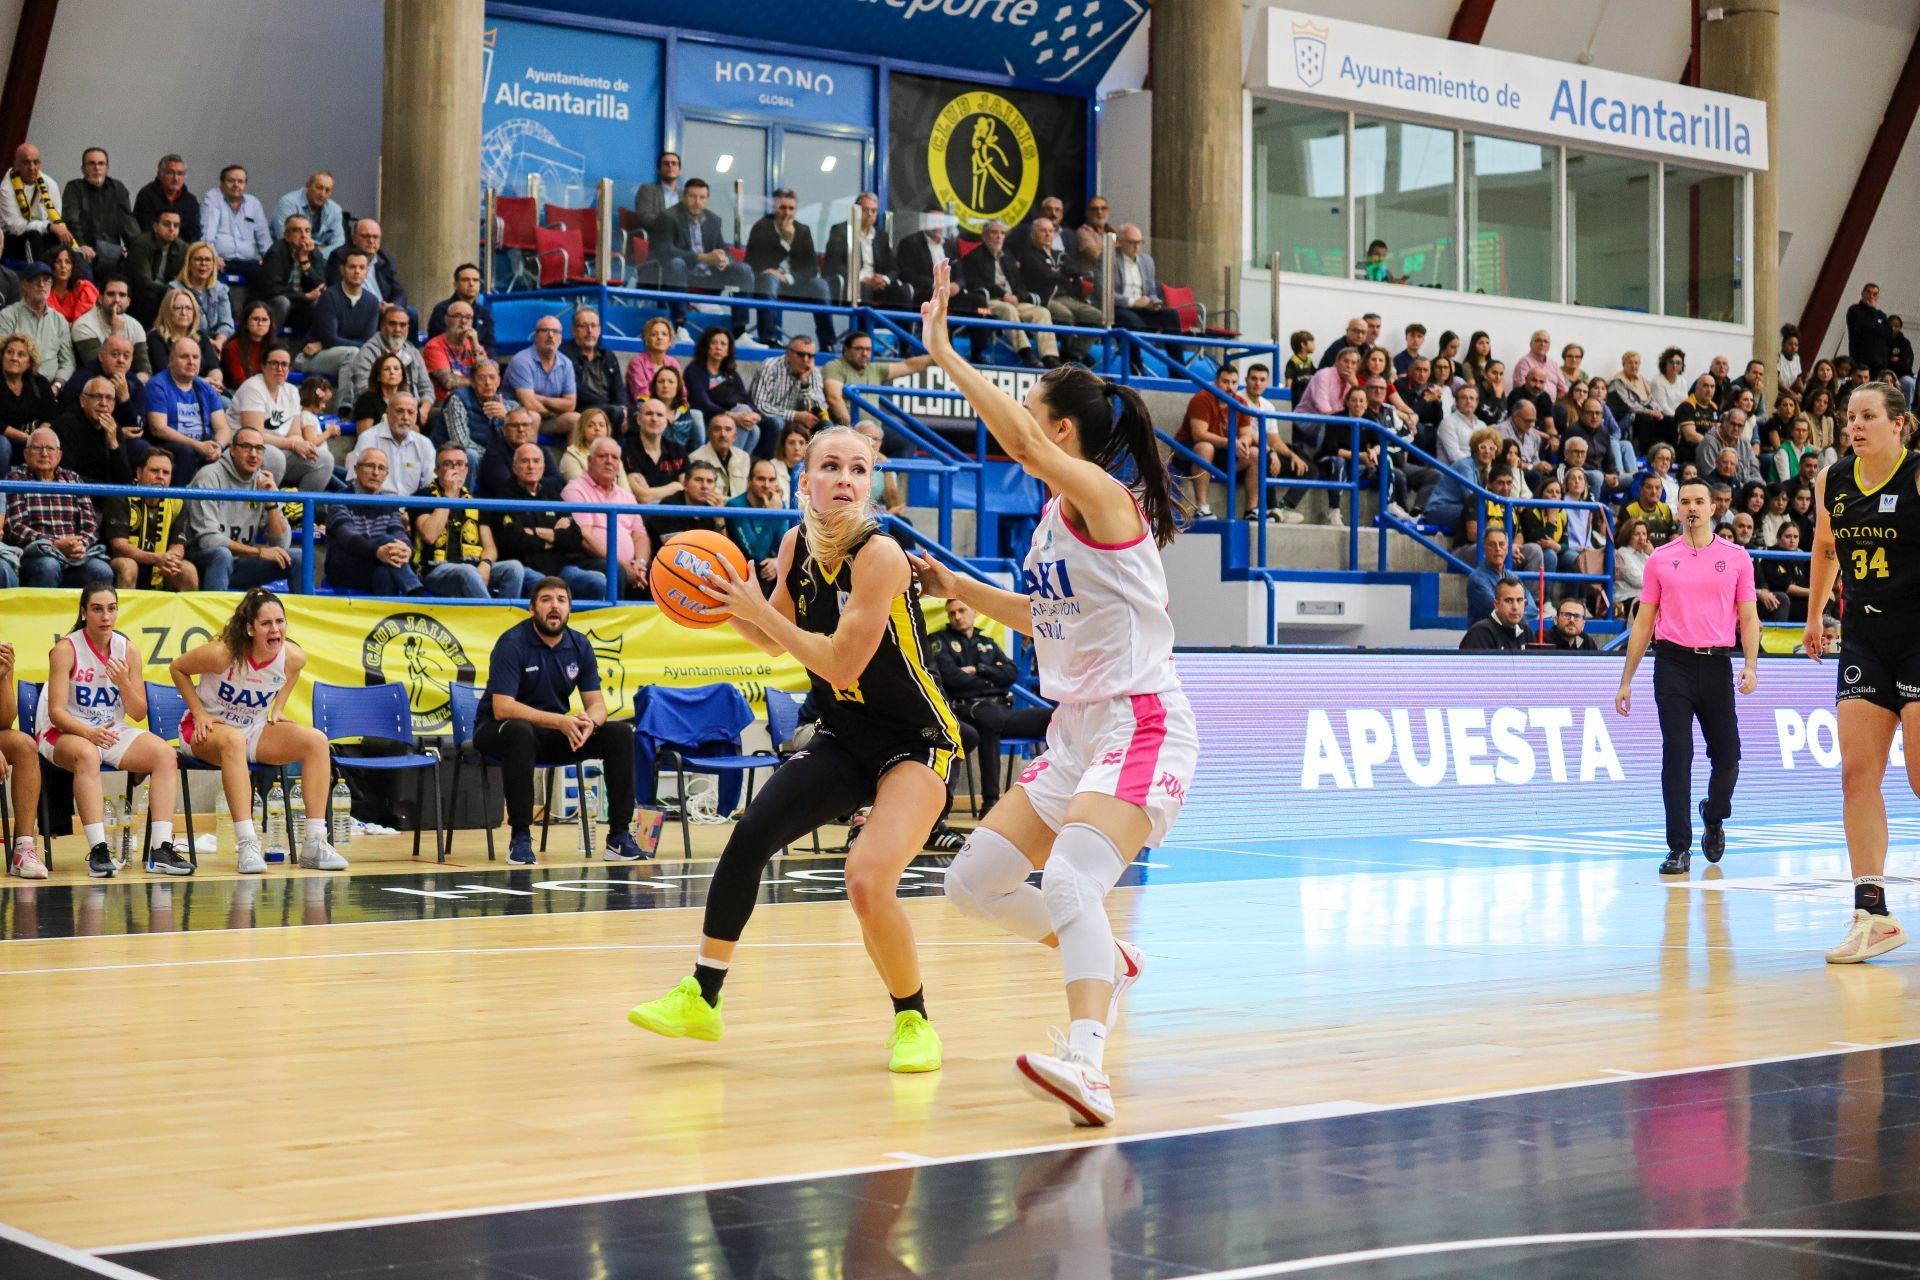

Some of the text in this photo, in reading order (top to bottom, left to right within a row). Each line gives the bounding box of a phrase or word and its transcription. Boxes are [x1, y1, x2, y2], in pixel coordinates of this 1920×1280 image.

[525, 67, 629, 93] Ayuntamiento de
[715, 61, 834, 95] HOZONO
[494, 82, 629, 121] Alcantarilla
[759, 94, 794, 107] GLOBAL
[1340, 55, 1751, 156] Ayuntamiento de Alcantarilla
[932, 94, 1035, 160] CLUB JAIRIS
[1832, 526, 1897, 539] HOZONO
[1023, 559, 1075, 601] AXI
[1852, 547, 1889, 579] 34
[366, 615, 467, 667] CLUB JAIRIS
[663, 664, 772, 679] Ayuntamiento de
[1301, 707, 1626, 789] APUESTA
